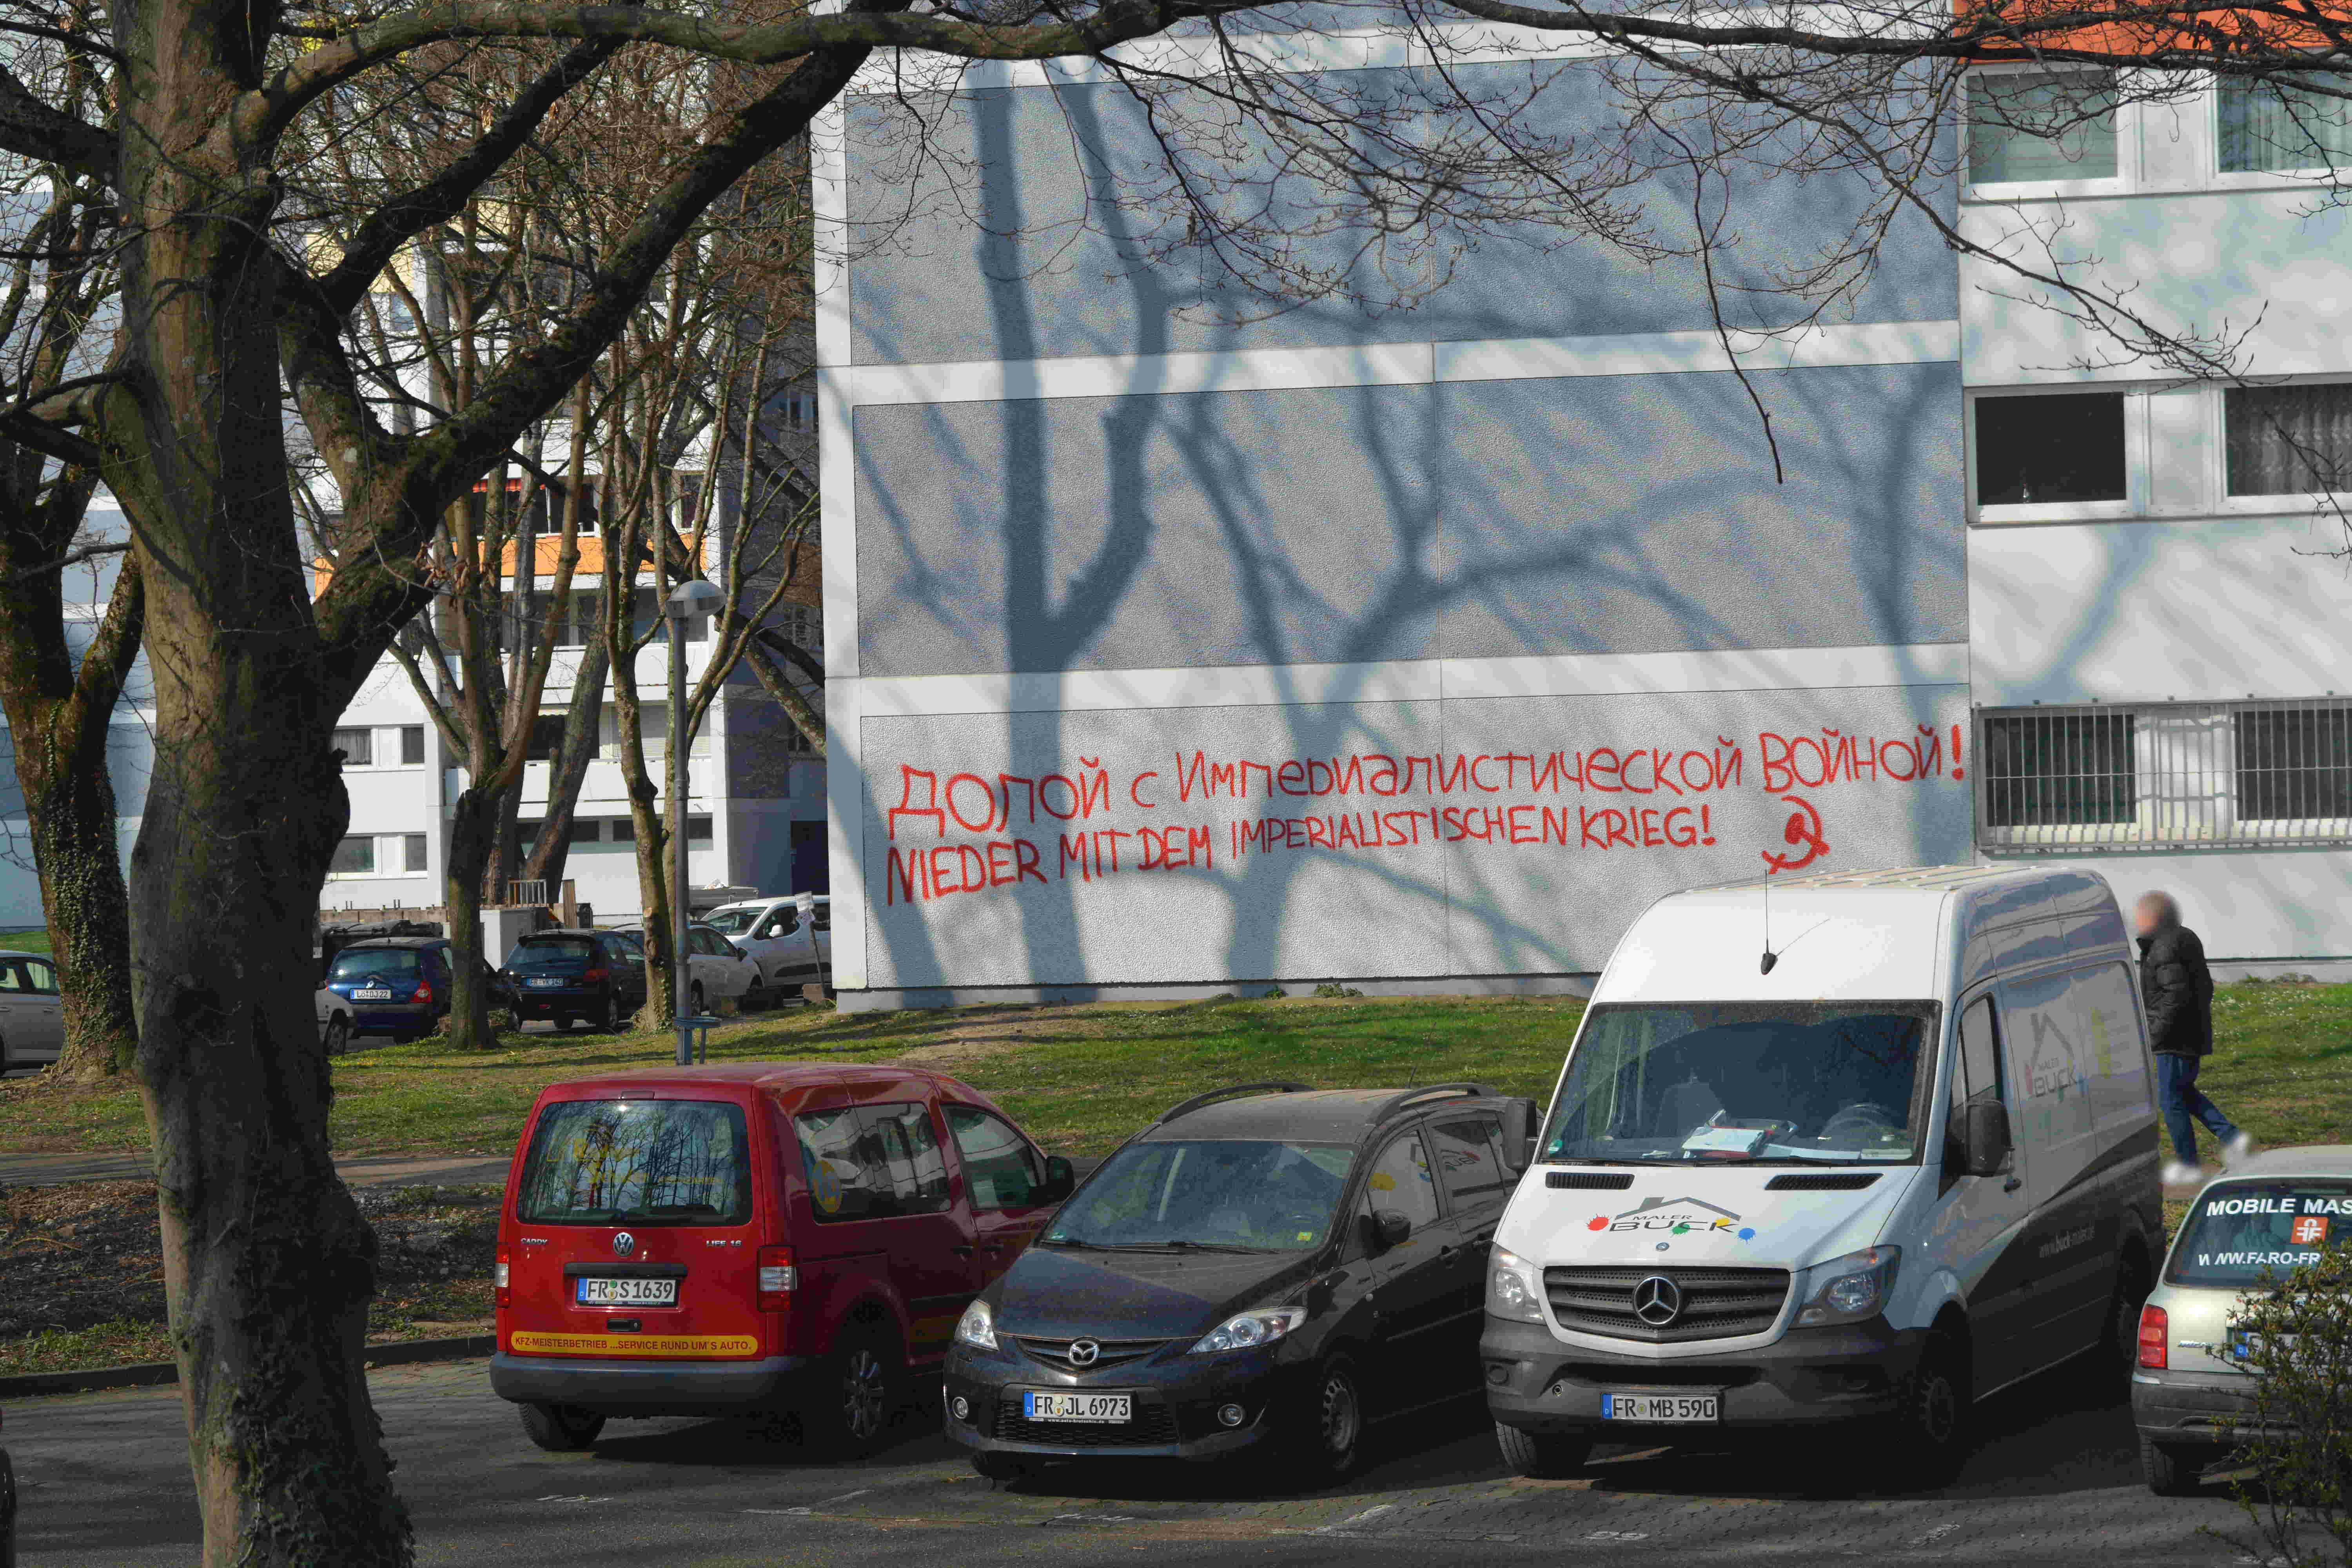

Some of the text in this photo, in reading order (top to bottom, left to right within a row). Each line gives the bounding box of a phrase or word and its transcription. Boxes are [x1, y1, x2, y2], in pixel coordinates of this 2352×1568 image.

[887, 804, 1717, 906] NIEDER MIT DEM IMPERIALISTISCHEN KRIEG!
[2207, 1198, 2296, 1216] MOBILE
[1609, 1221, 1739, 1233] BUCK
[588, 1281, 608, 1298] FR
[619, 1281, 630, 1298] S
[632, 1281, 673, 1299] 1639
[515, 1337, 607, 1348] KFZ-MEISTERBETRIEB
[661, 1341, 688, 1350] RUND
[1034, 1396, 1053, 1414] FR
[1065, 1397, 1085, 1416] JL
[1089, 1397, 1128, 1416] 6973
[1613, 1398, 1637, 1417] FR
[1649, 1399, 1674, 1418] MB
[1678, 1399, 1715, 1418] 590
